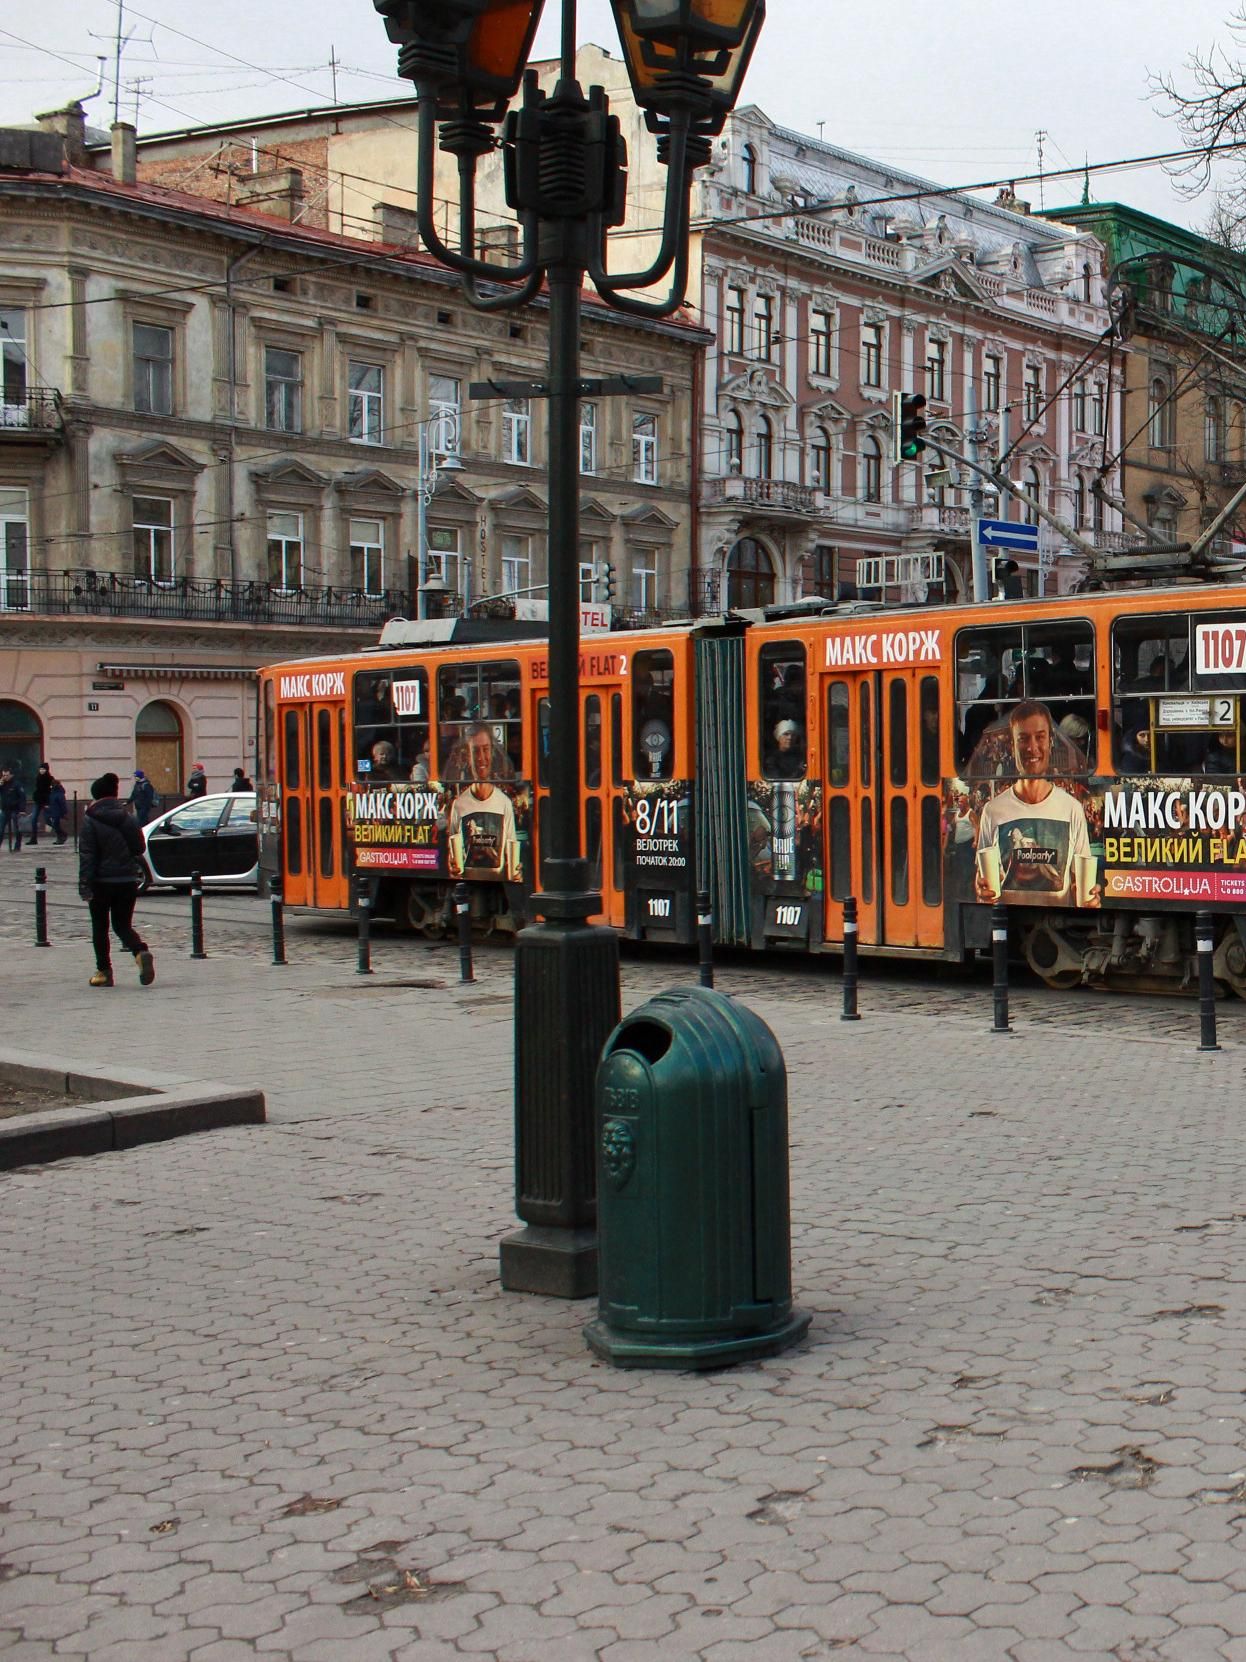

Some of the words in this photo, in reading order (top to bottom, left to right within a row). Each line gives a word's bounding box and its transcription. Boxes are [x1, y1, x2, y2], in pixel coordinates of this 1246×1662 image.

[825, 634, 878, 666] МАКС
[881, 629, 941, 662] КОРЖ
[1202, 629, 1246, 668] 1107
[590, 655, 616, 676] FLAT
[619, 655, 628, 675] 2
[280, 674, 311, 698] МАКС
[311, 672, 345, 696] КОРЖ
[396, 685, 417, 711] 1107
[1219, 700, 1231, 721] 2
[355, 792, 394, 819] МАКС
[396, 792, 438, 820] КОРЖ
[636, 798, 678, 836] 8/11
[1104, 791, 1181, 829] МАКС
[404, 825, 430, 843] FLAT
[636, 839, 679, 852] ВЕЛОТРЕК
[1105, 831, 1203, 863] ВЕЛИКИЙ
[636, 855, 668, 866] ПОЧАТОК
[668, 857, 686, 867] 20:00
[1220, 879, 1245, 887] TICKETS
[648, 899, 670, 916] 1107
[776, 906, 801, 925] 1107
